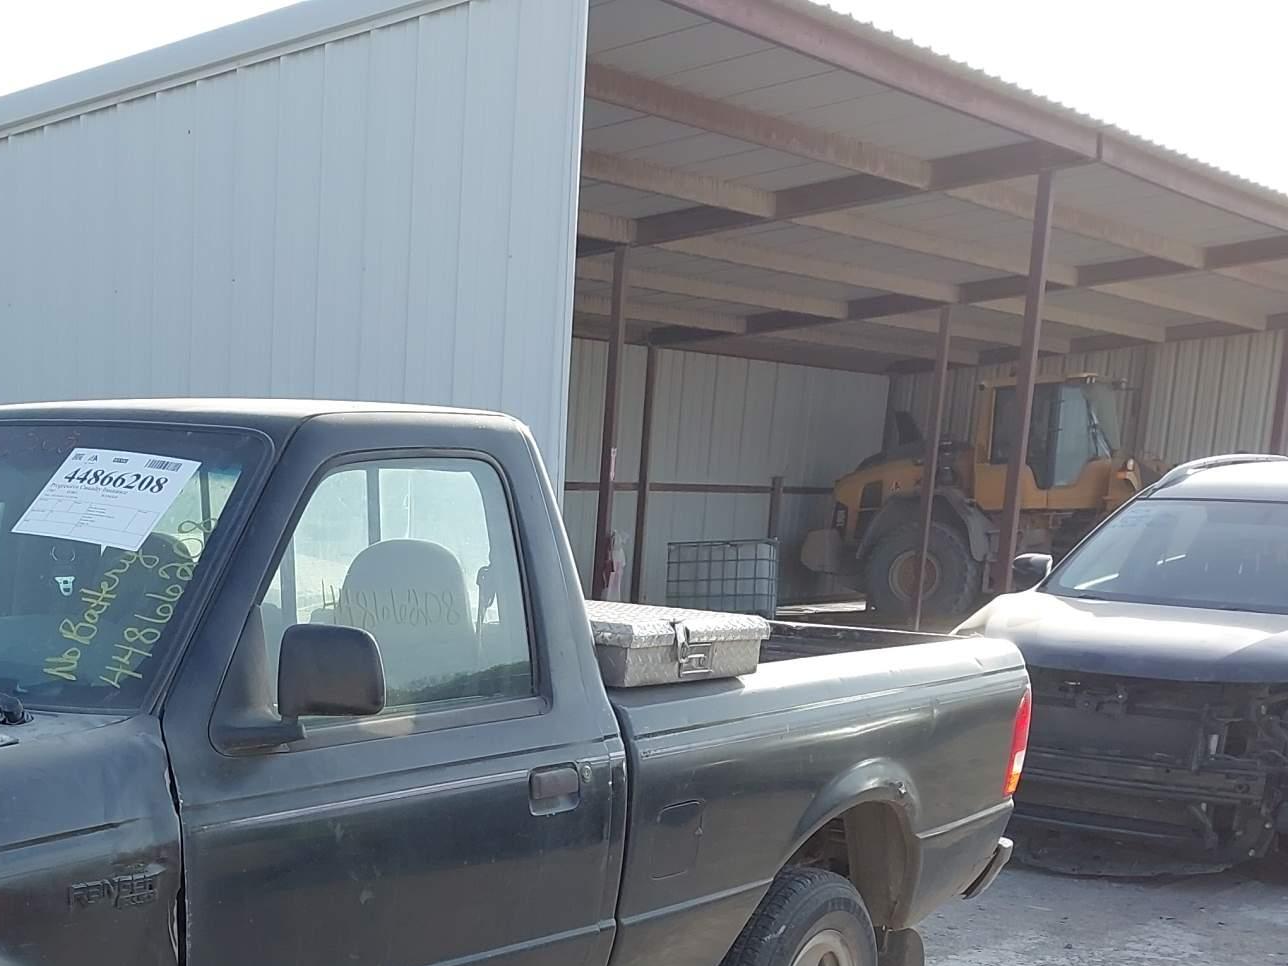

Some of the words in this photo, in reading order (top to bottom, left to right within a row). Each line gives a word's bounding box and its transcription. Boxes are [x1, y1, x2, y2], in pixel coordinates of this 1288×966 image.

[64, 468, 168, 493] 44866208
[59, 550, 159, 645] Battery
[99, 518, 217, 688] 44866208
[43, 646, 81, 681] No
